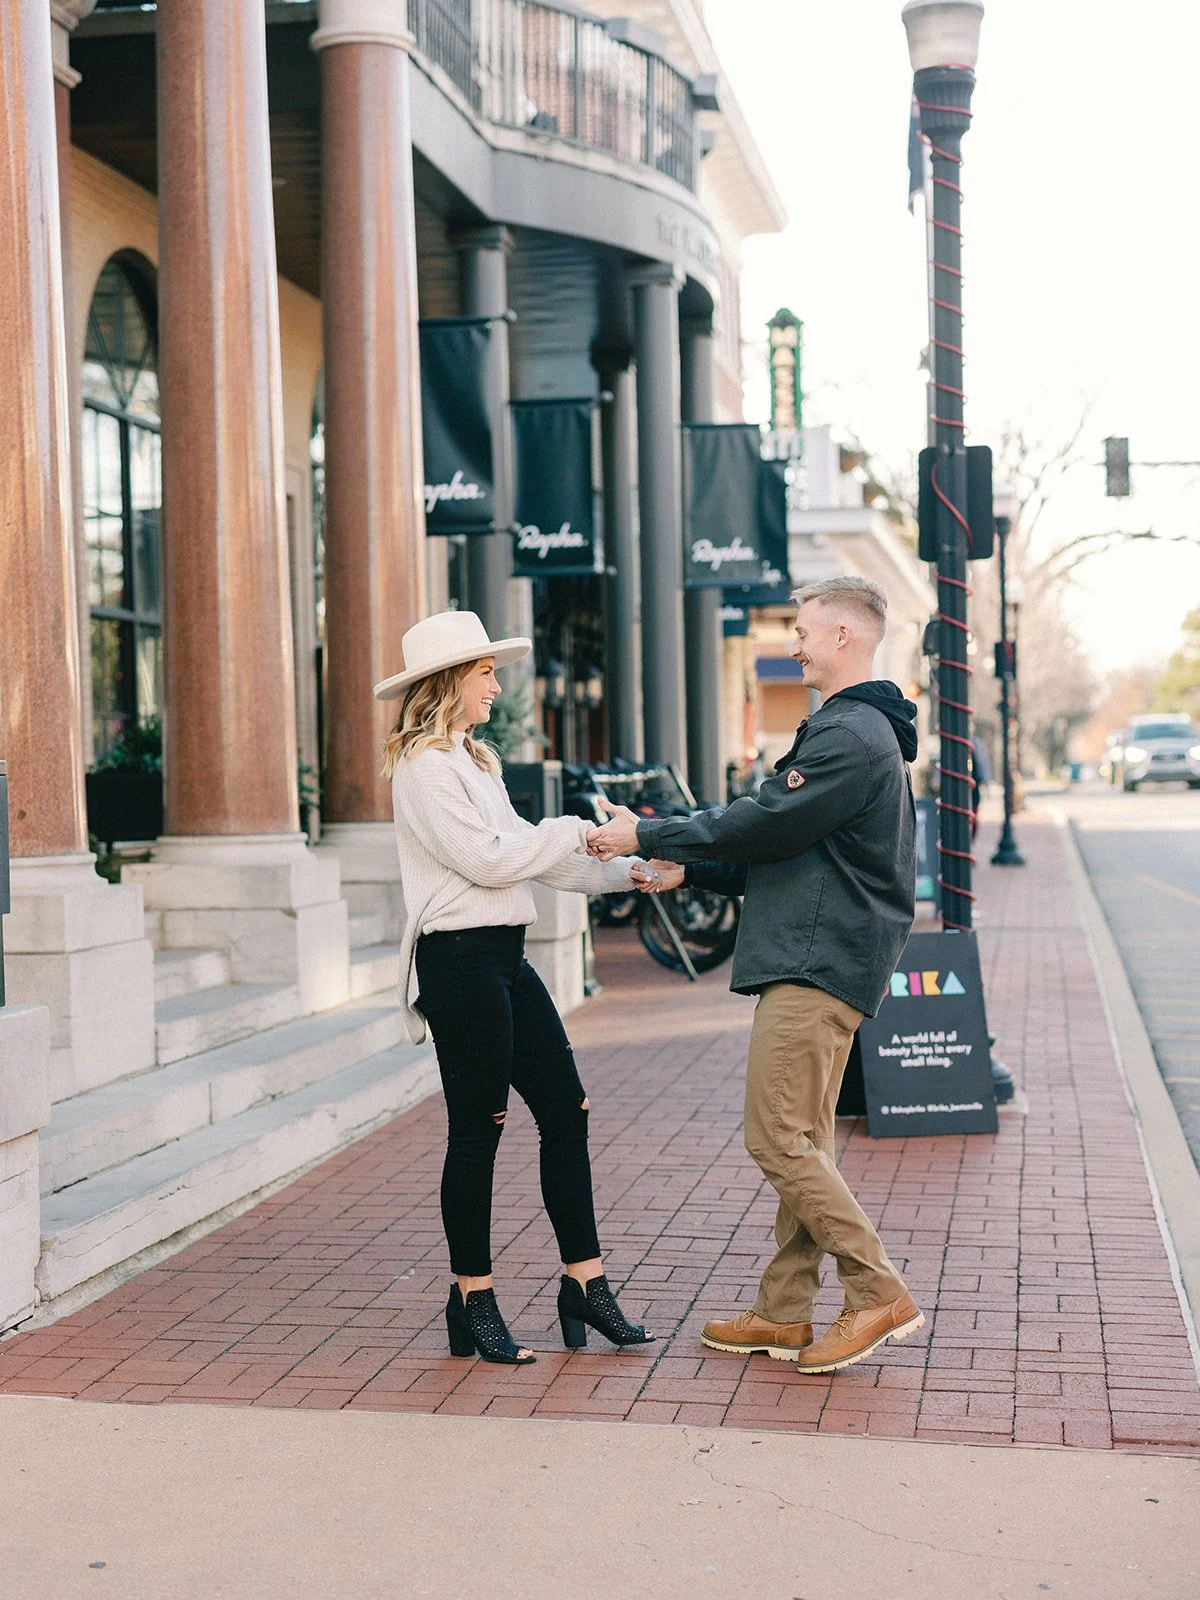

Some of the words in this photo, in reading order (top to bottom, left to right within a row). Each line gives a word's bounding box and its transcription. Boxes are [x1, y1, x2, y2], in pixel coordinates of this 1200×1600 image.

[885, 971, 967, 997] RIKA
[891, 1033, 901, 1044] A
[901, 1032, 929, 1044] world
[929, 1031, 945, 1043] full
[946, 1030, 957, 1042] of
[878, 1045, 911, 1057] beauty
[912, 1044, 933, 1055] lives
[934, 1043, 945, 1054] in
[945, 1044, 972, 1055] every
[900, 1055, 925, 1068] small
